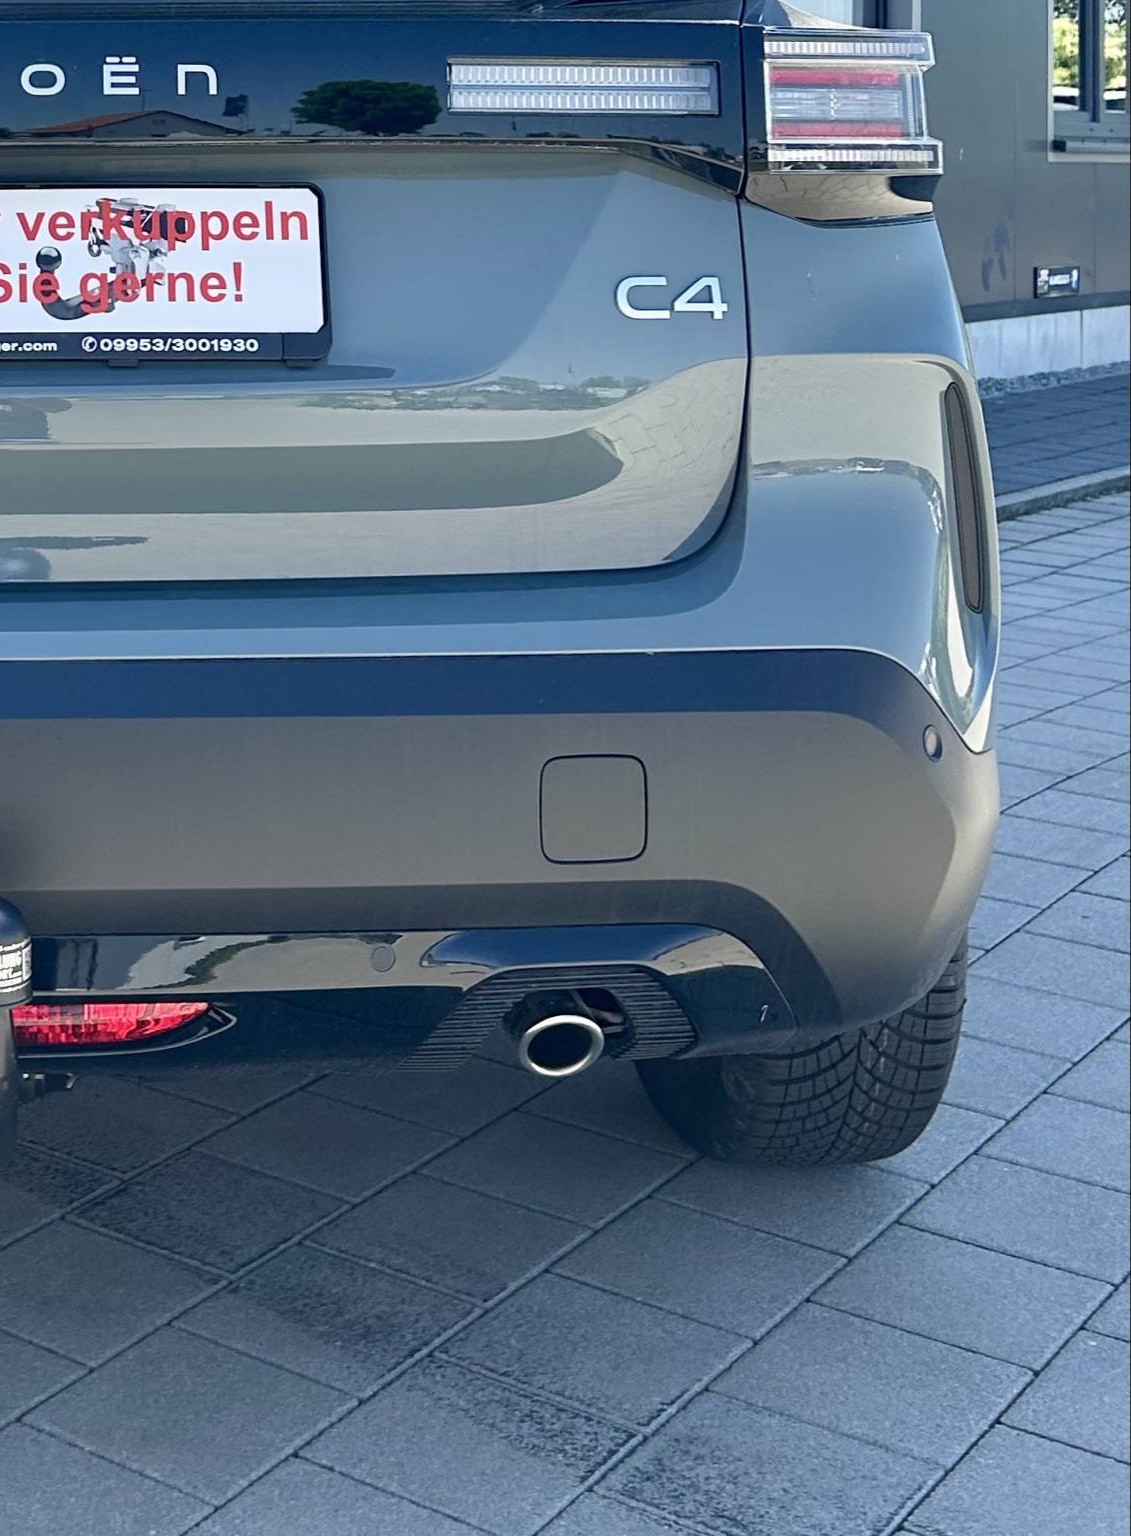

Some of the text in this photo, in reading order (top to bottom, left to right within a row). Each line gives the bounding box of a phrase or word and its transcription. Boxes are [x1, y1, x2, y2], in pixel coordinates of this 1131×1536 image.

[15, 200, 309, 252] verkuppeln
[79, 261, 244, 315] gerne!
[615, 275, 729, 320] C4
[99, 337, 259, 354] 09953/3001930
